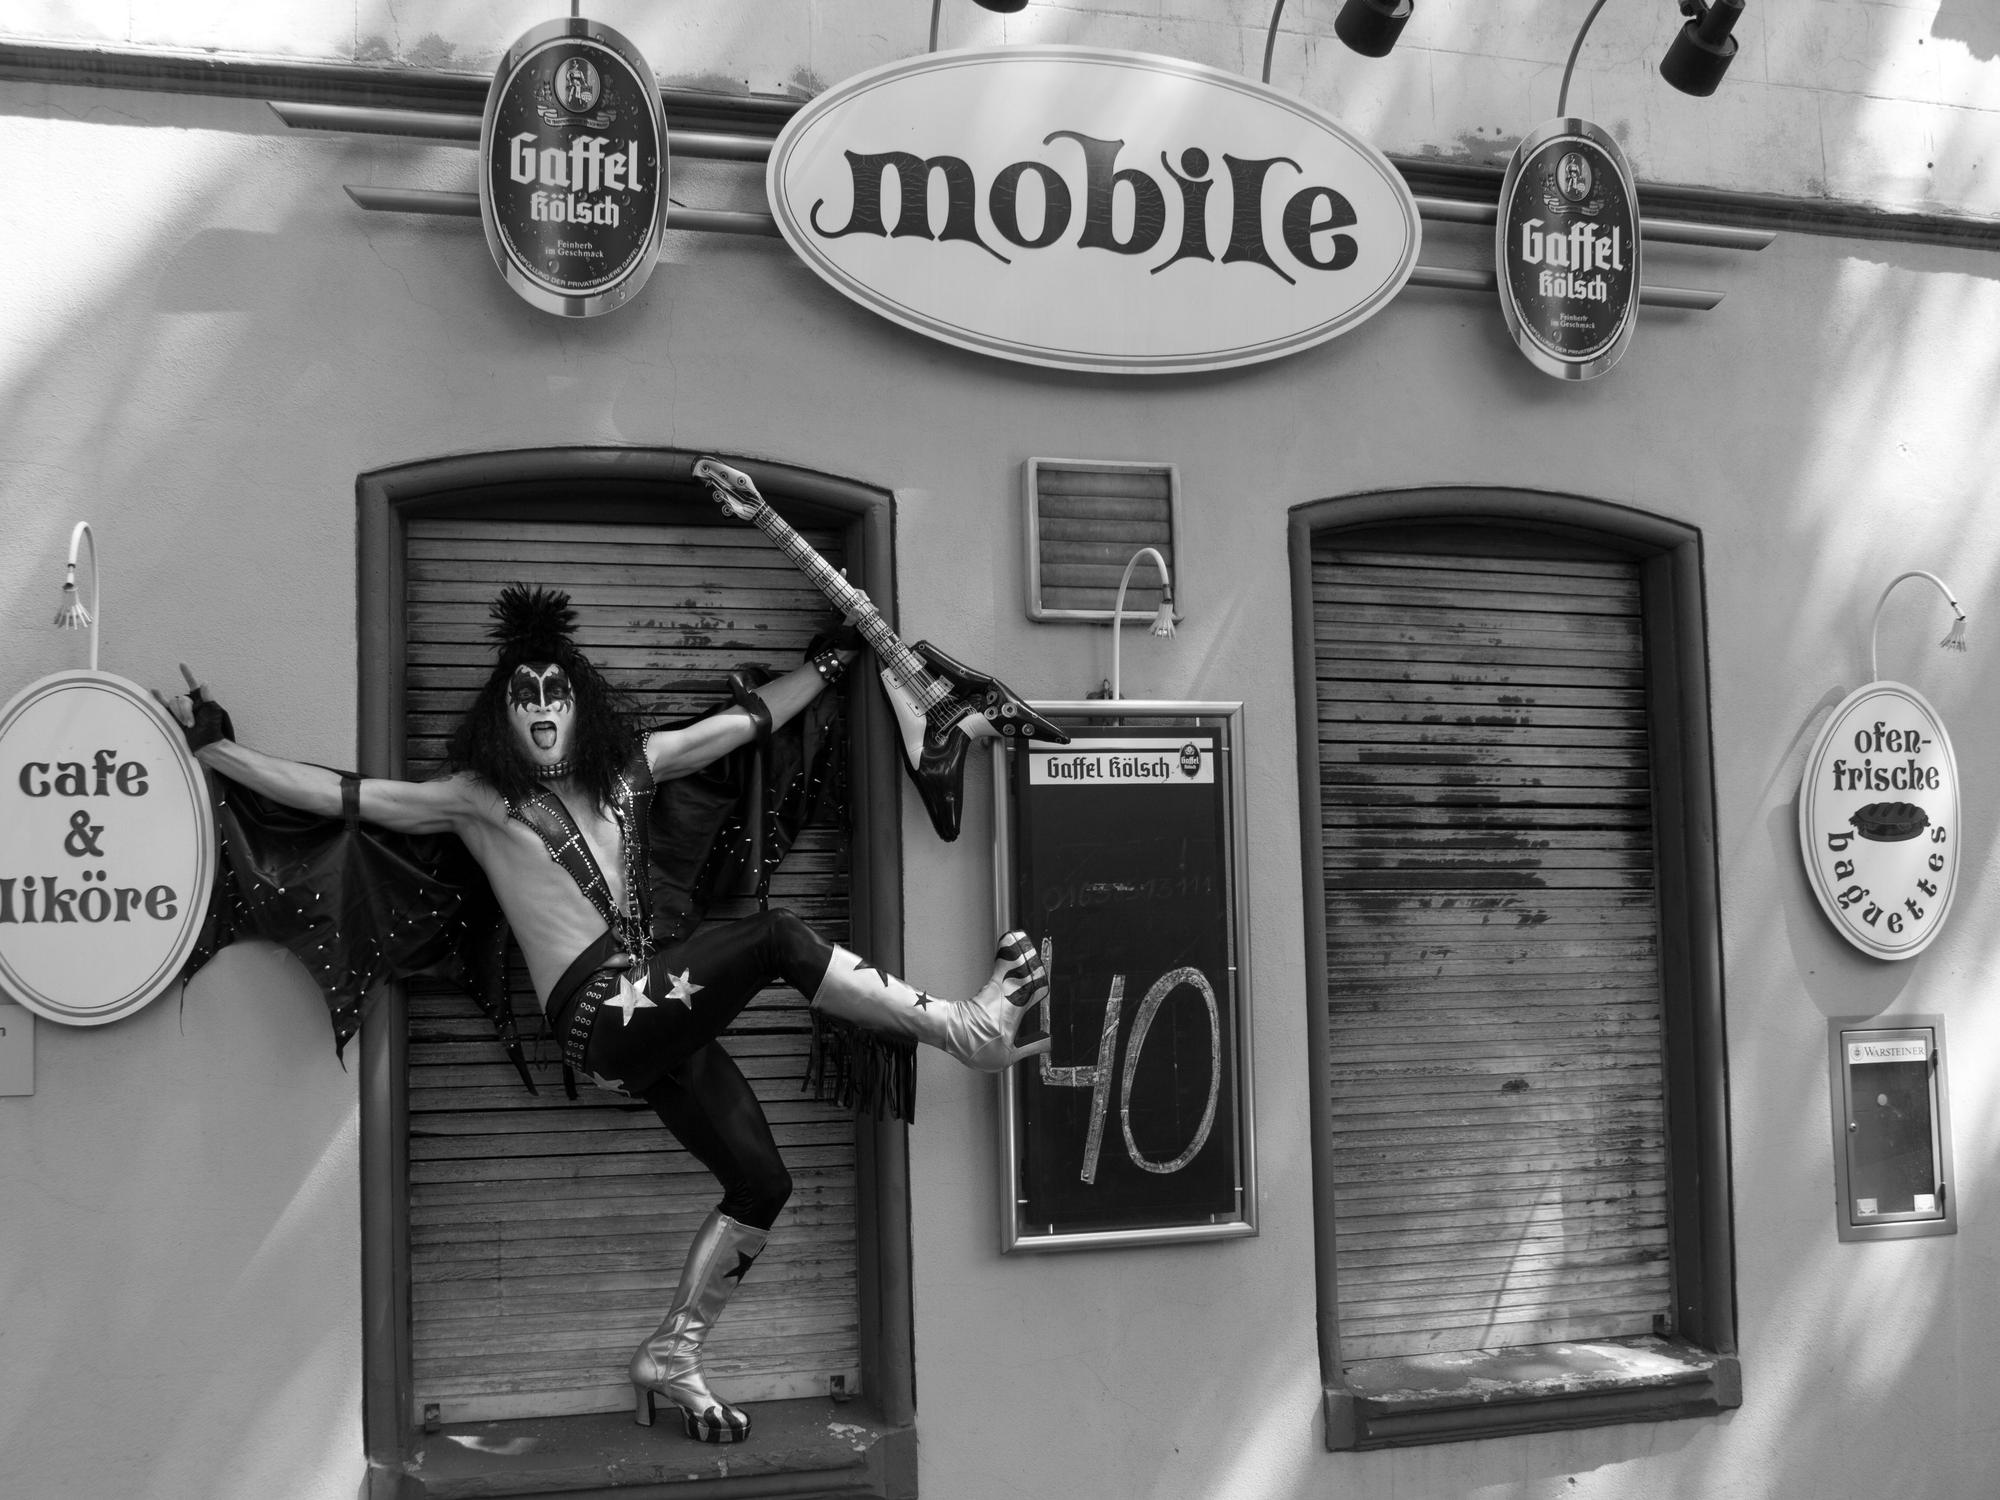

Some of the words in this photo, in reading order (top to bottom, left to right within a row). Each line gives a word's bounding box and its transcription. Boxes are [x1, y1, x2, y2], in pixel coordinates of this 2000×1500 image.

[510, 132, 643, 193] Gaffel
[531, 191, 619, 228] Kölsch
[810, 130, 1358, 286] mobile
[557, 240, 593, 249] Feinherb
[557, 248, 604, 258] Geschmack
[1522, 218, 1623, 272] Gaffel
[550, 276, 566, 286] DER
[1539, 269, 1607, 303] Kölsch
[1854, 721, 1931, 754] ofen-
[19, 749, 149, 798] cafe
[1047, 757, 1103, 780] Gaffel
[1109, 757, 1170, 780] Kölsch
[1832, 759, 1940, 791] frische
[64, 810, 104, 857] &
[0, 870, 178, 924] liköre
[1828, 826, 1946, 933] baguettes
[1039, 937, 1221, 1184] 40
[1864, 1046, 1925, 1057] WARSTEINER
